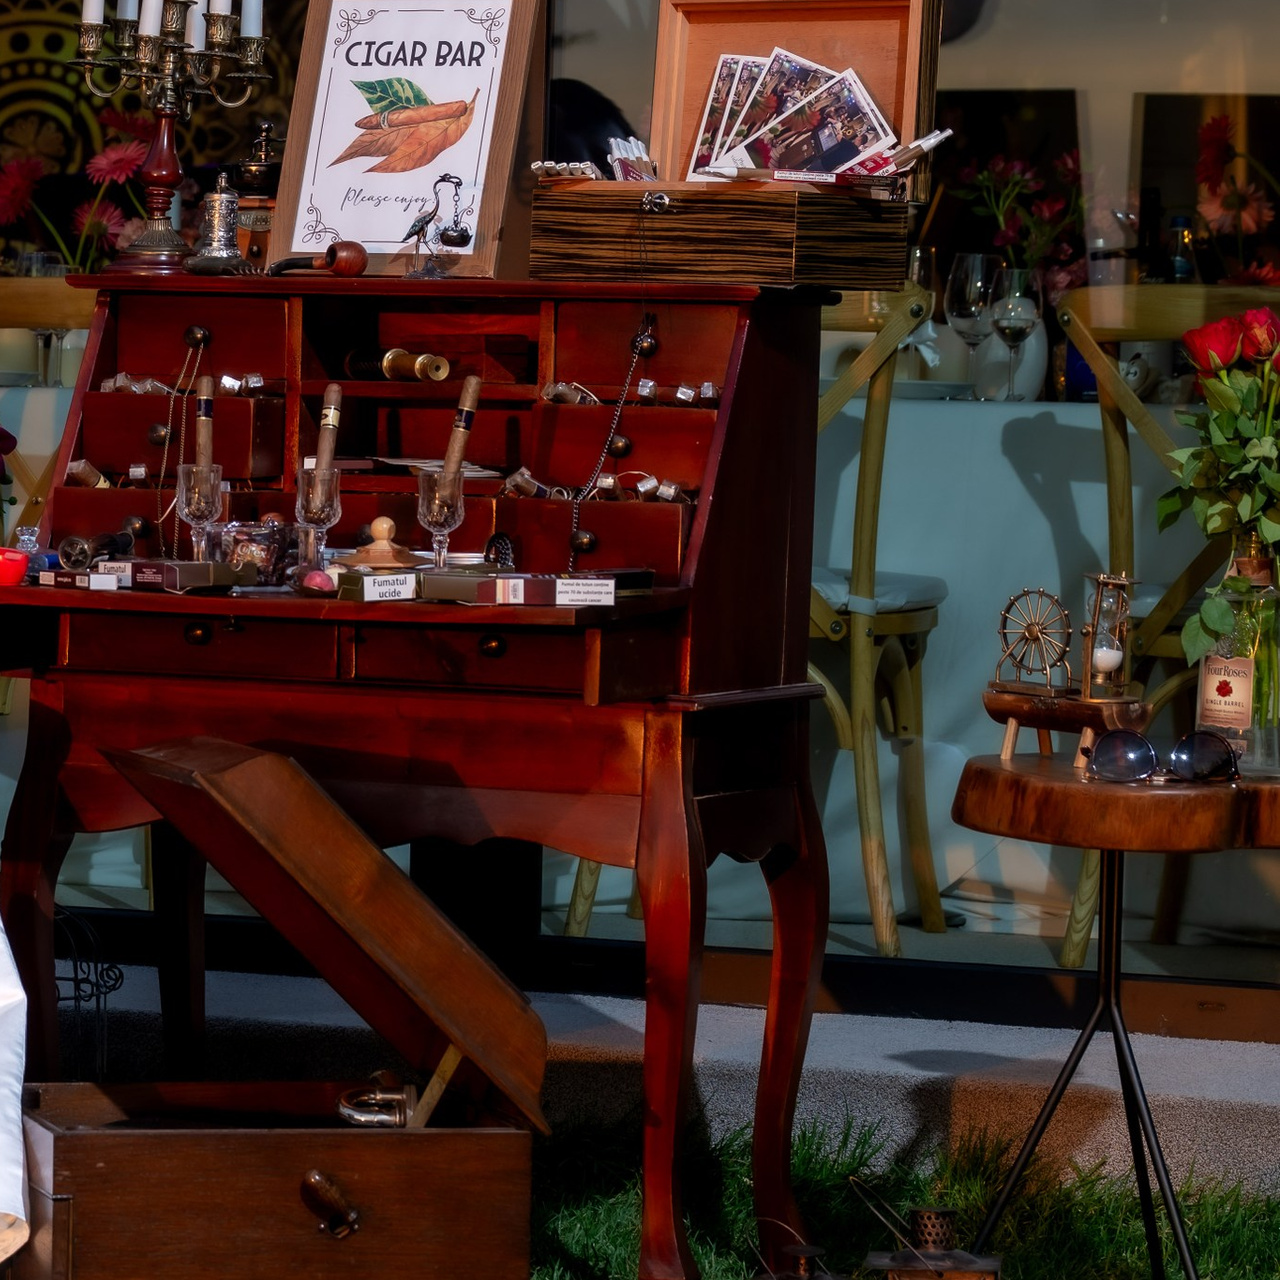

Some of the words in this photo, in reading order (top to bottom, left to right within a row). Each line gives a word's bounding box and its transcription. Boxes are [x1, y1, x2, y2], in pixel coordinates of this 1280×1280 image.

[344, 40, 428, 67] CIGAR
[434, 40, 486, 67] BAR
[340, 187, 392, 211] Please
[372, 576, 408, 587] Fumatul
[378, 588, 402, 598] ucide
[1207, 664, 1223, 676] Four
[1223, 665, 1248, 678] Roses
